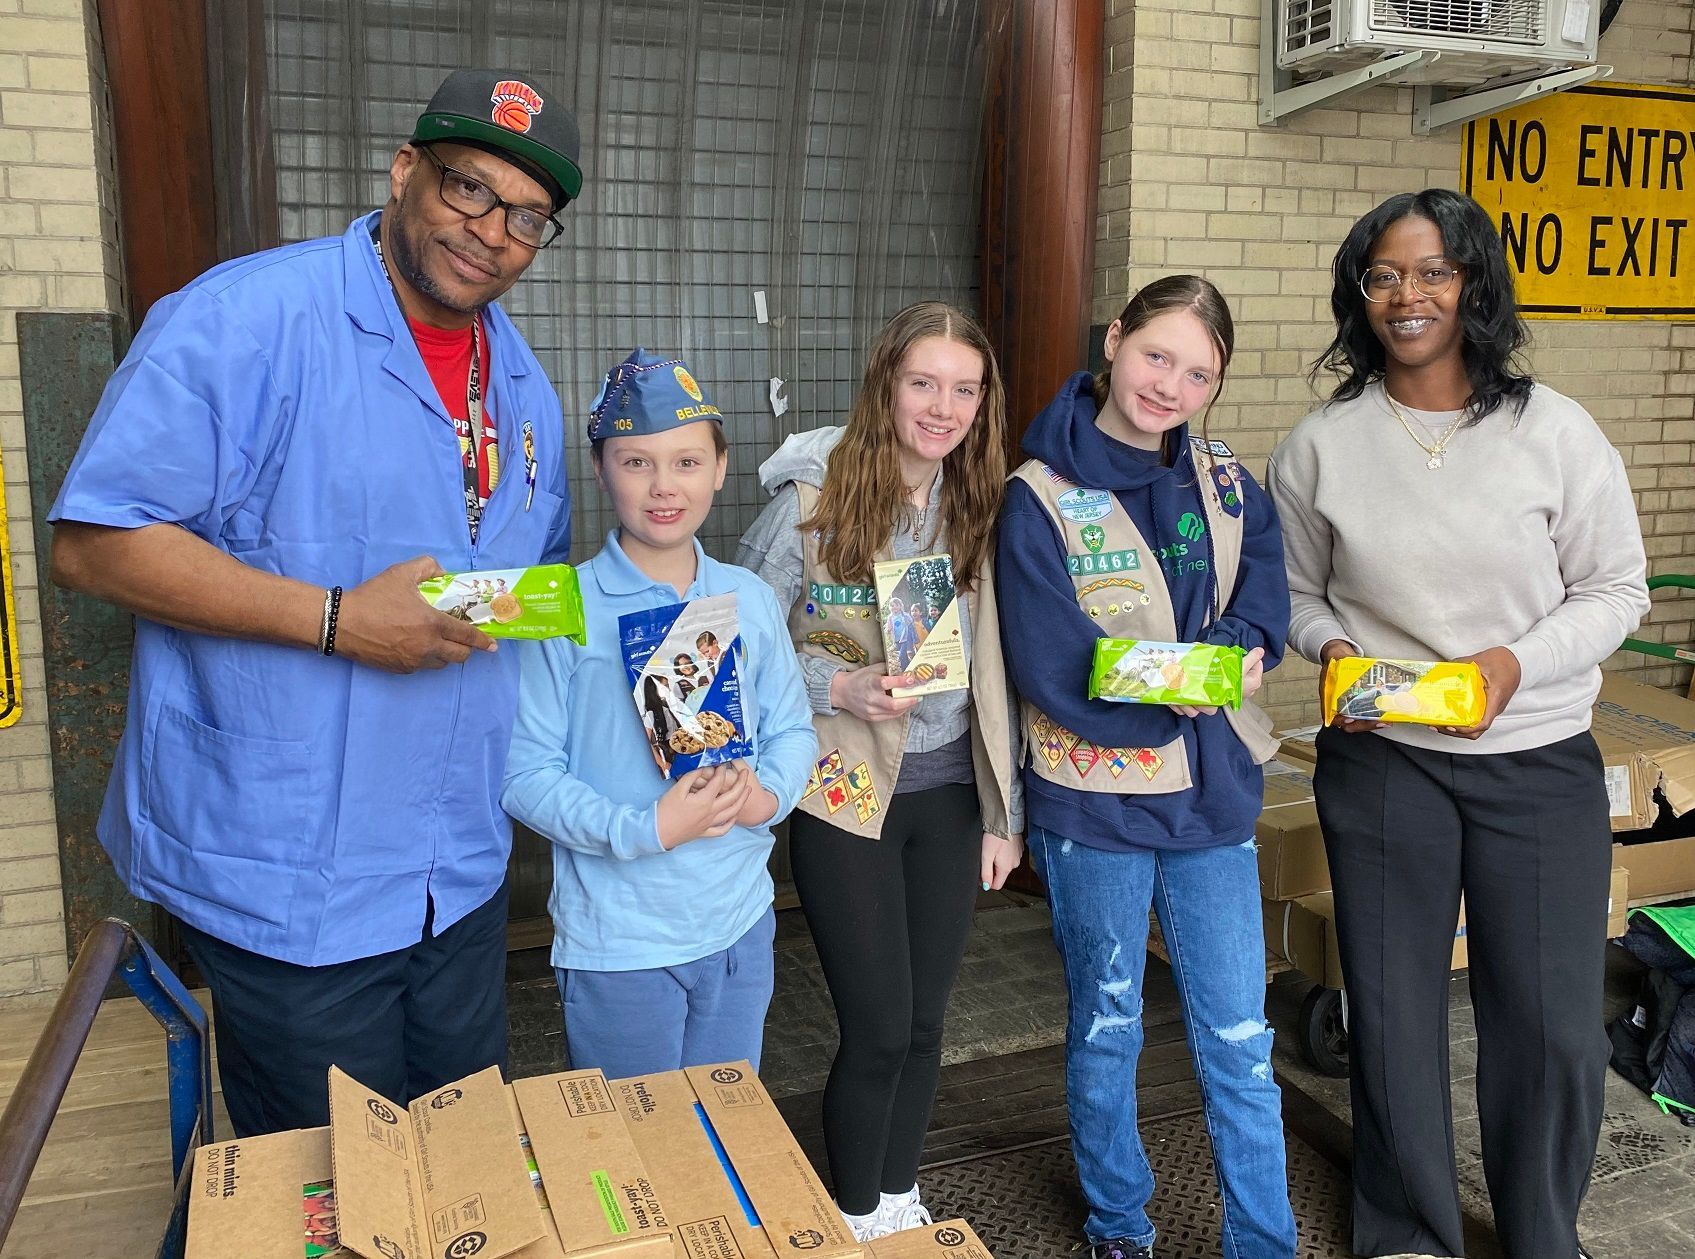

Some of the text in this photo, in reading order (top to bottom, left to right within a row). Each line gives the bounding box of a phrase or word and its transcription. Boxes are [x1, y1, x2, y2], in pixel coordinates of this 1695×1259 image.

[1486, 118, 1695, 191] NO ENTR
[1501, 211, 1687, 277] NO EXIT
[614, 418, 633, 431] 105
[1071, 552, 1137, 571] 20462
[811, 584, 876, 603] 20122
[566, 1081, 587, 1113] Perishable
[620, 1085, 643, 1122] DO NOT DROP
[633, 1082, 656, 1114] trefoils
[206, 1148, 220, 1198] DO NOT DROP
[223, 1144, 240, 1199] thin mints
[637, 1179, 667, 1226] DO NOT DROP
[686, 1226, 697, 1237] DRY
[697, 1224, 709, 1236] KEEP
